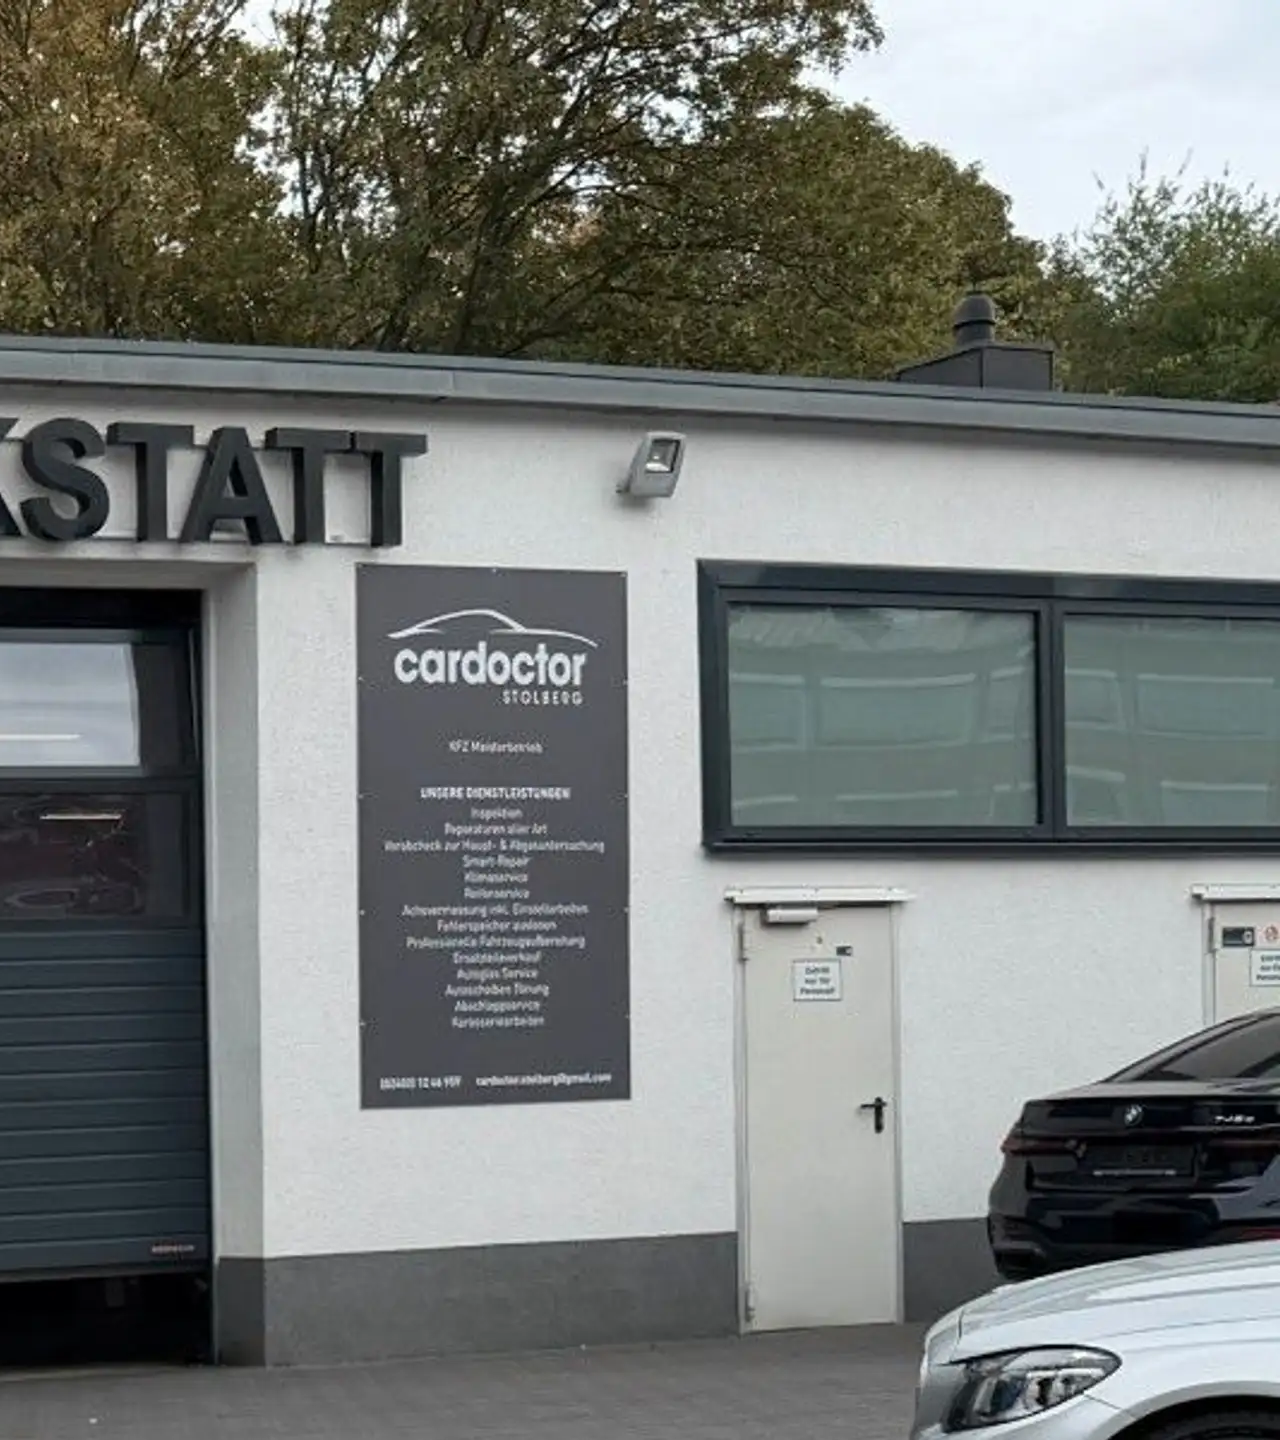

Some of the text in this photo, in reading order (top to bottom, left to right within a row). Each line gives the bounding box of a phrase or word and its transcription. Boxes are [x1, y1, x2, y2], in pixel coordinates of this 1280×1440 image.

[393, 641, 587, 686] cardoctor
[502, 689, 584, 705] STOLBERG
[449, 739, 469, 752] KFZ
[419, 786, 572, 799] UNSERE DIENSTLEISTUNGEN
